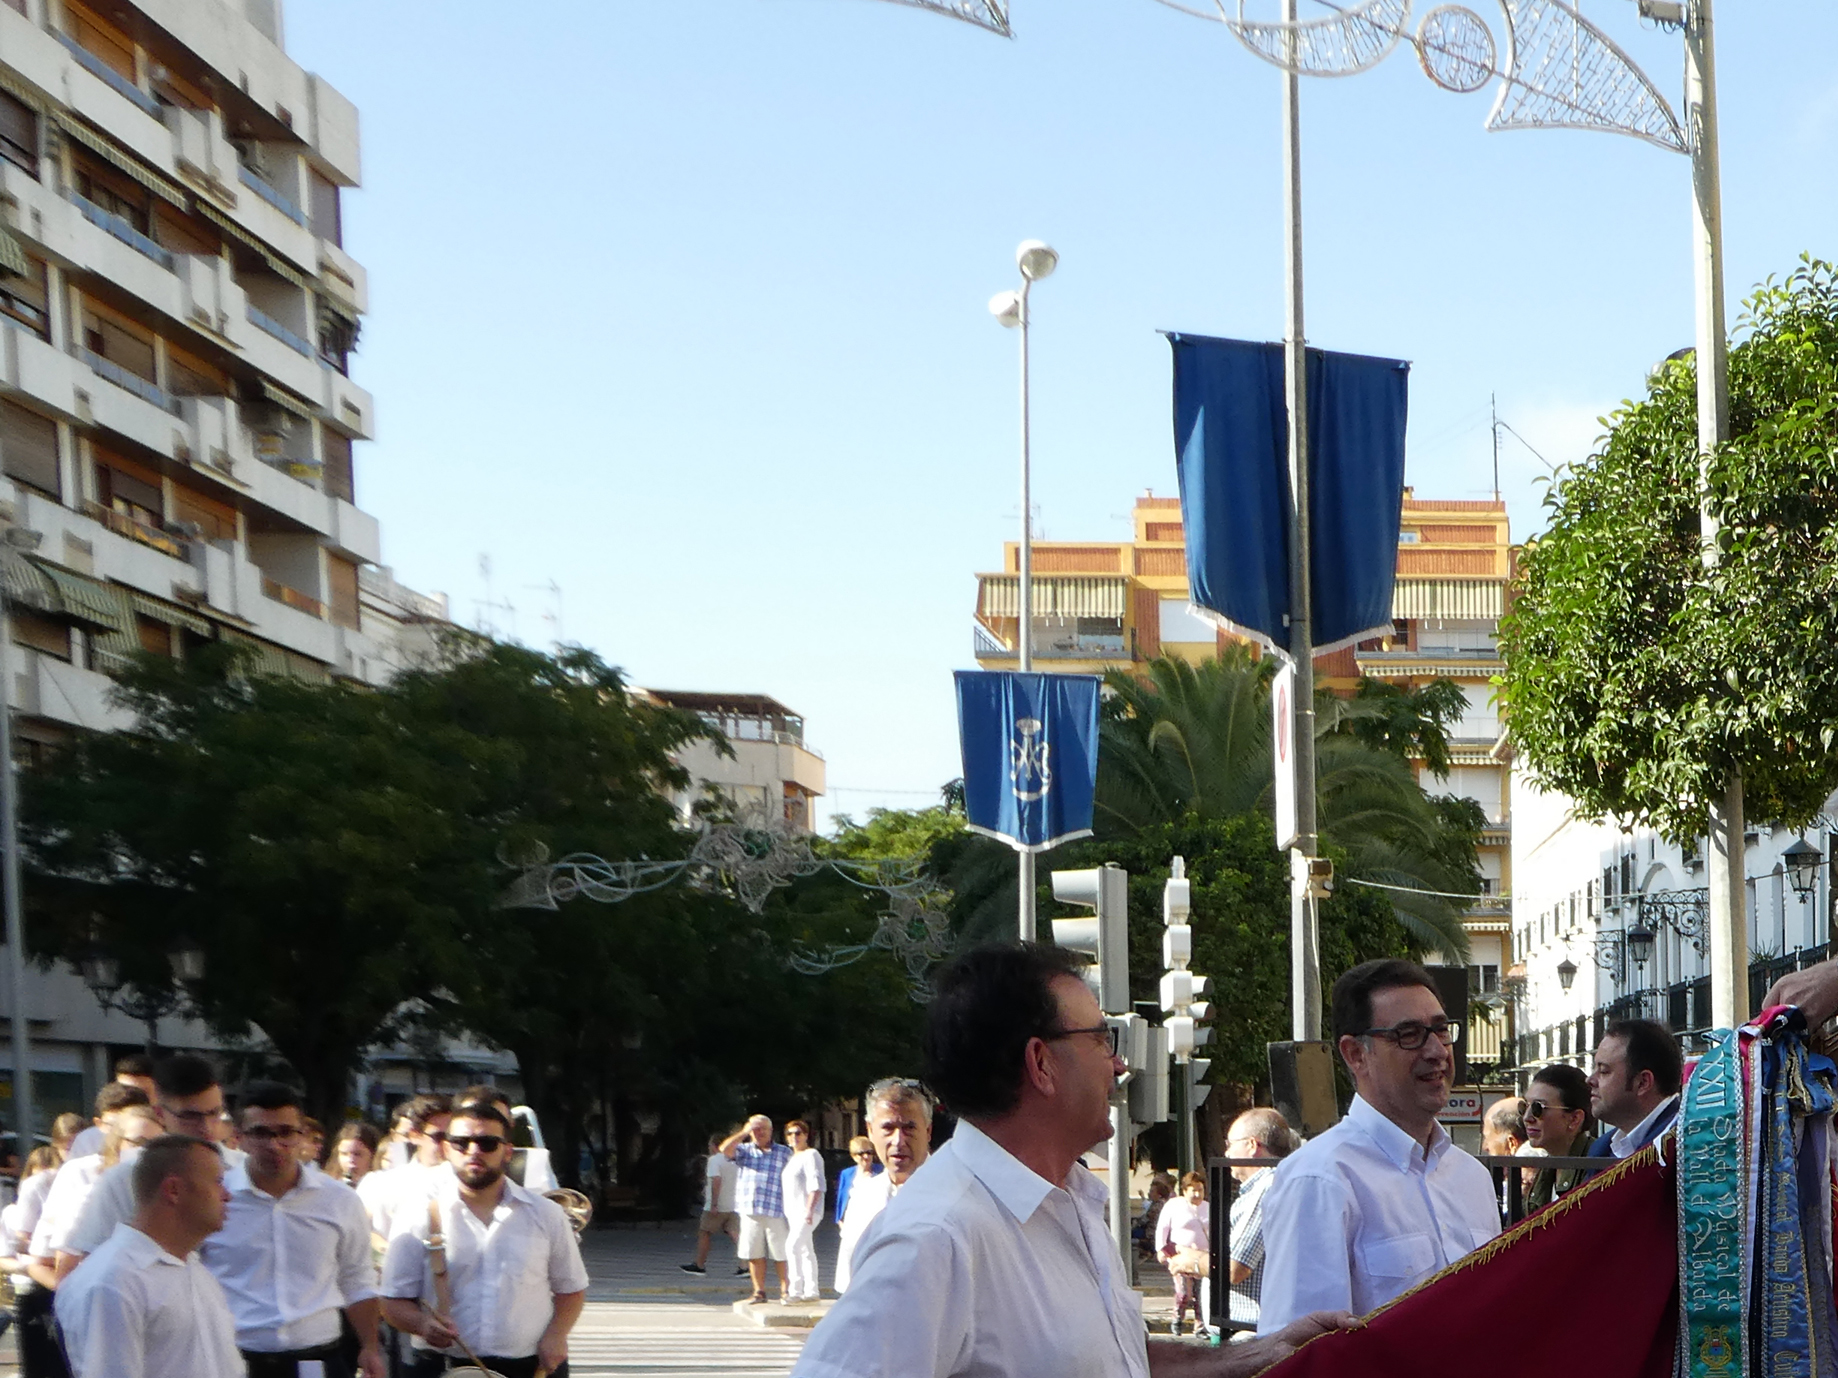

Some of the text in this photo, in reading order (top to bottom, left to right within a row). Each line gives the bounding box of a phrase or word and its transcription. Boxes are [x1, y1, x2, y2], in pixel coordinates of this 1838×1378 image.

[1688, 1117, 1709, 1135] la
[1689, 1143, 1711, 1184] Vall
[1711, 1116, 1733, 1184] Diada
[1717, 1288, 1739, 1312] de
